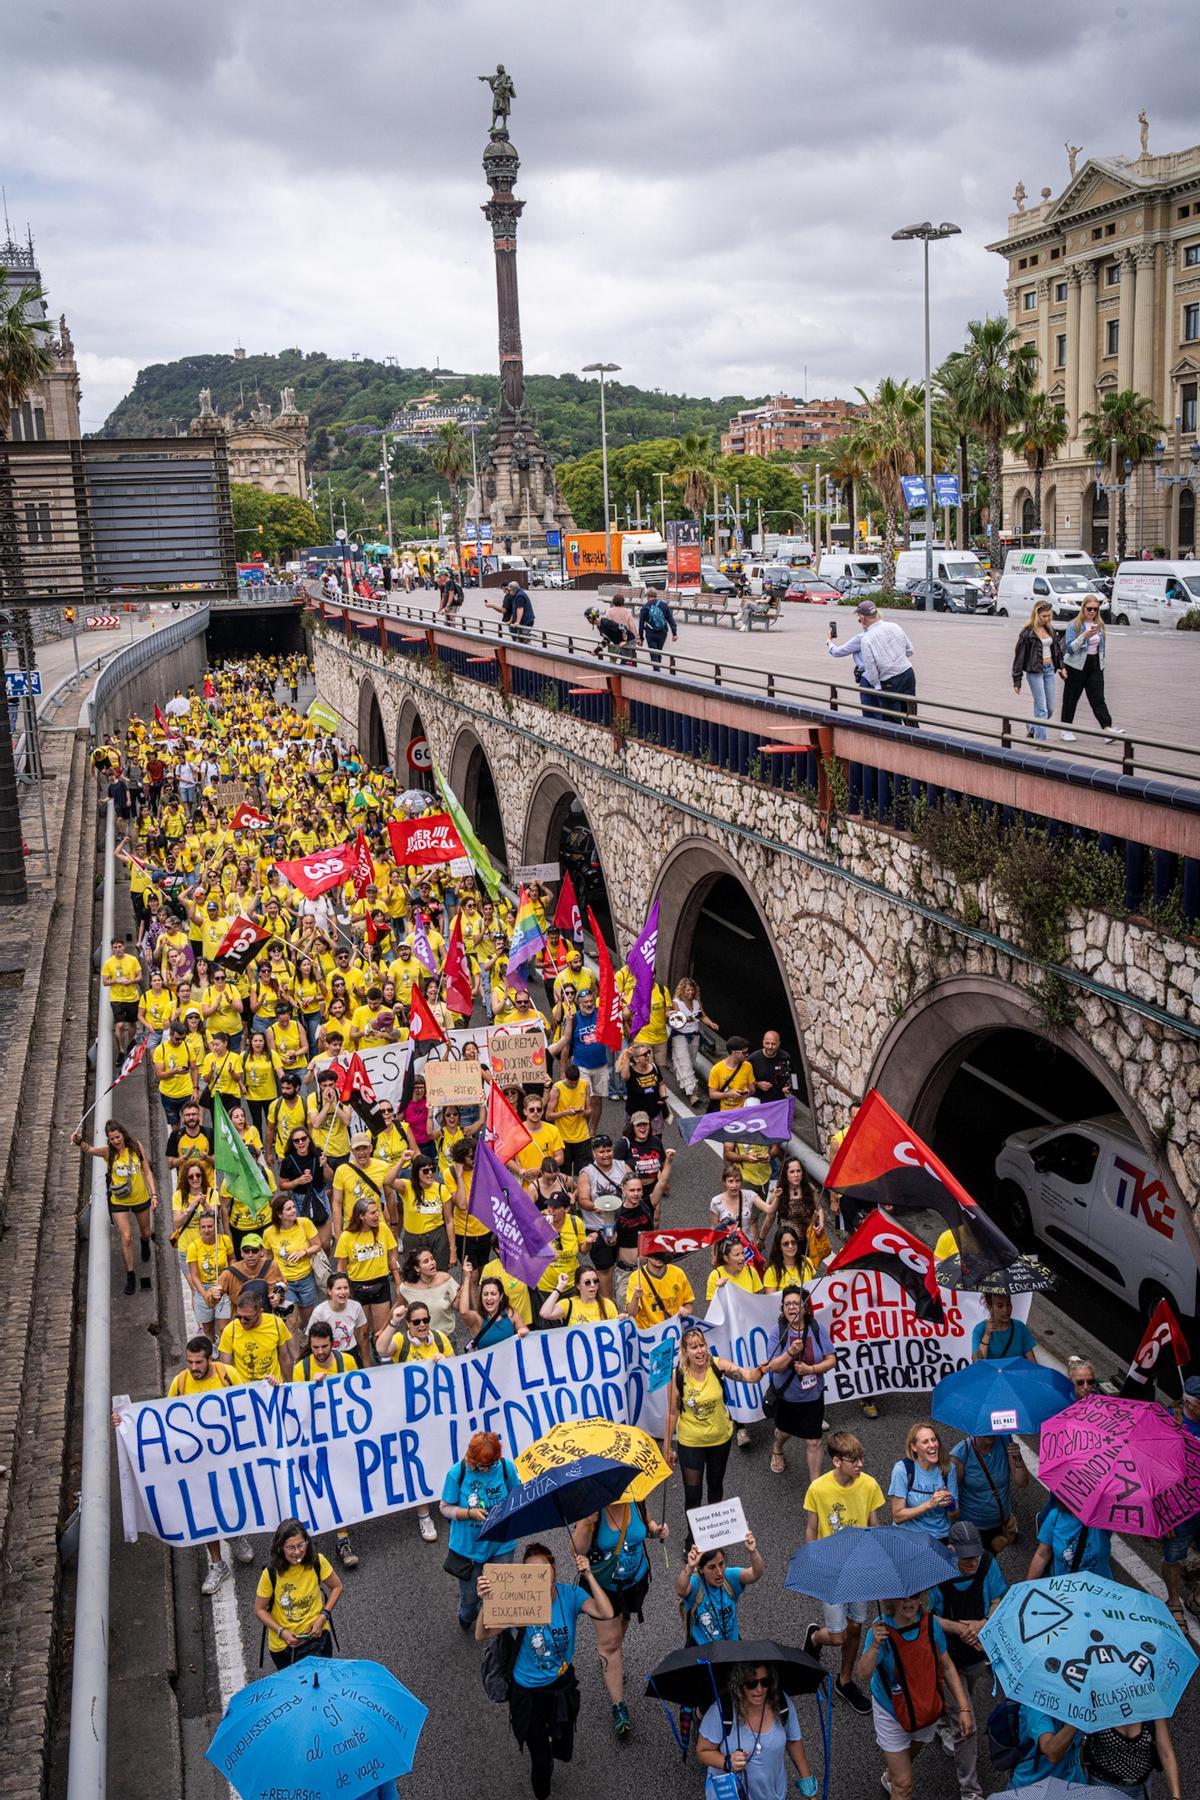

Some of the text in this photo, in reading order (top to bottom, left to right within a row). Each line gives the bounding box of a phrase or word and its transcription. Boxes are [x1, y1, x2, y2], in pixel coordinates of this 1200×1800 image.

[240, 813, 271, 829] CGT
[223, 927, 257, 960] CGT
[1114, 1155, 1176, 1241] TKE
[871, 1233, 930, 1275] CG
[829, 1308, 965, 1344] RECURSOS
[403, 1351, 502, 1424] BAIX
[355, 1429, 434, 1515] PER
[547, 1454, 566, 1465] NO
[1054, 1444, 1123, 1514] VII CONVENI
[1108, 1460, 1145, 1529] PAE
[491, 1606, 543, 1618] EDUCATIVA?
[500, 1590, 545, 1602] COMUNITAT
[1101, 1608, 1125, 1621] VII
[306, 1726, 369, 1763] al comité
[335, 1757, 385, 1789] de vaga
